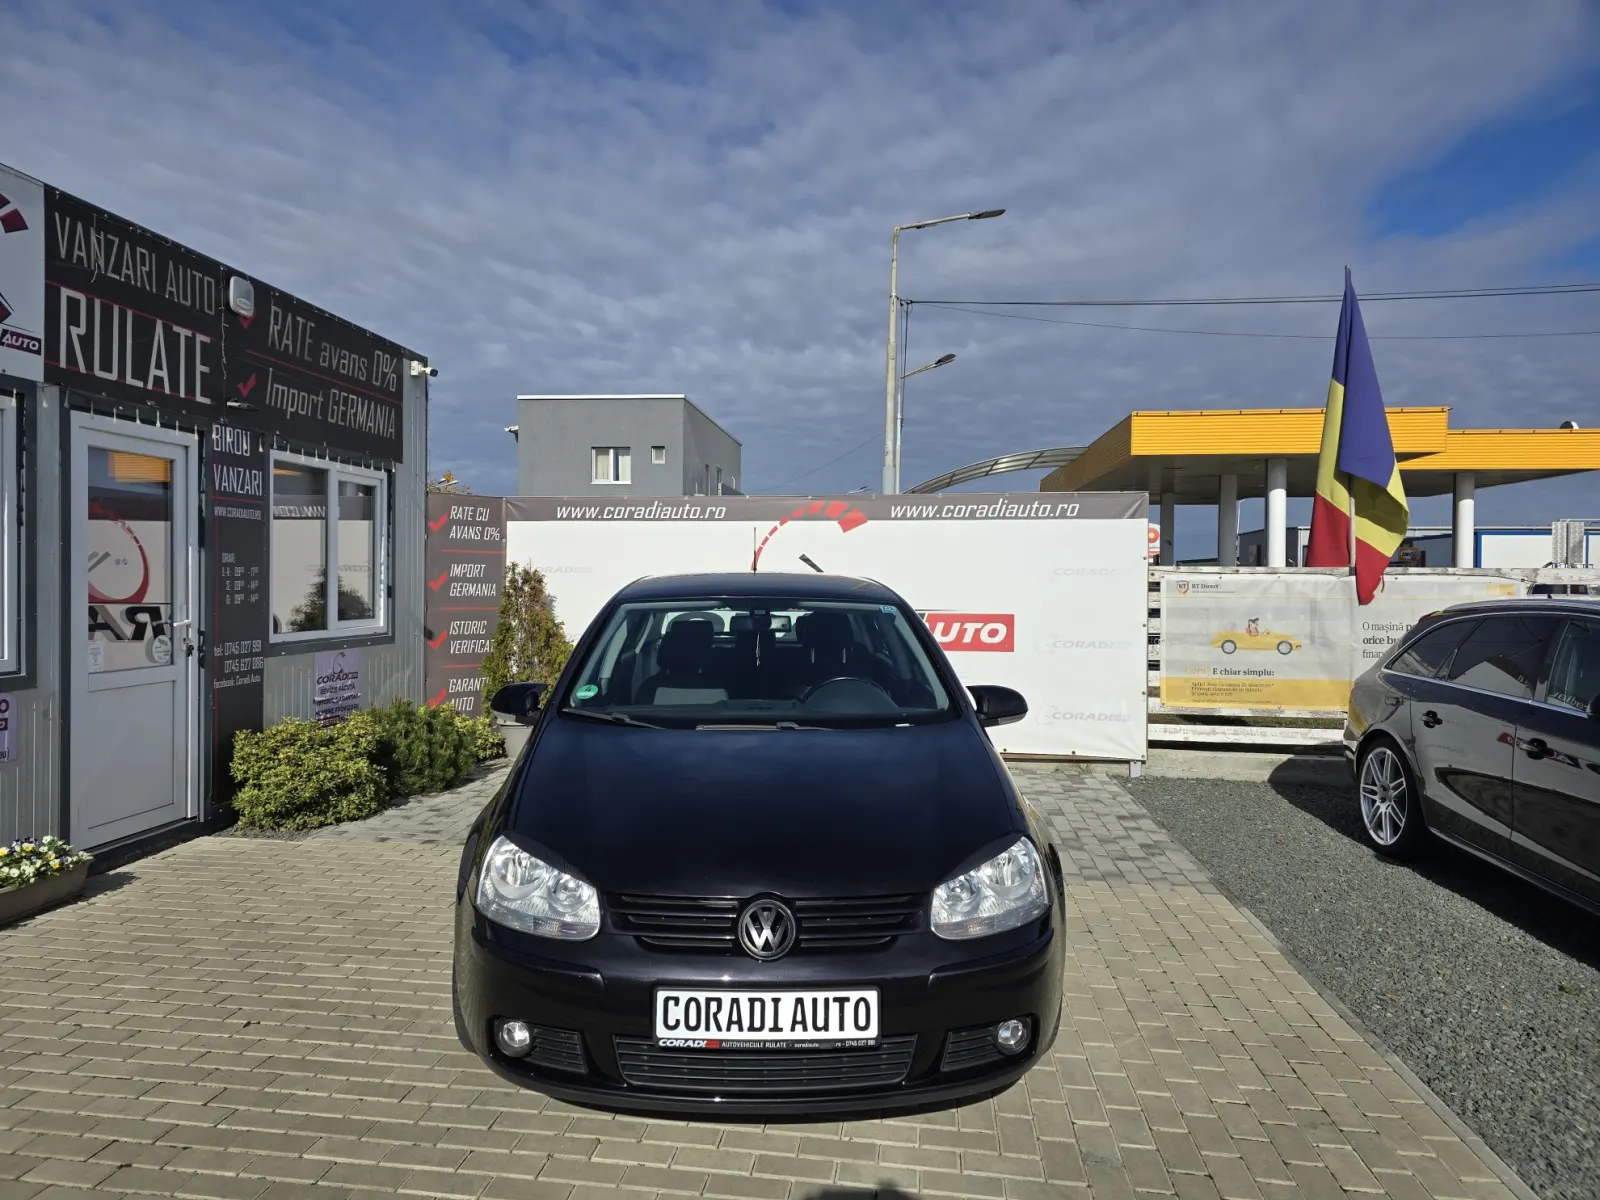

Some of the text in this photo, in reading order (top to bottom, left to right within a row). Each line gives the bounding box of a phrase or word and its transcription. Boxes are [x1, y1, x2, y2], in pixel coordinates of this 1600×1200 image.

[54, 211, 216, 316] VANZARI AUTO
[2, 333, 39, 350] AUTO
[59, 286, 212, 404] RULATE
[268, 305, 397, 392] RATE avans 0%
[266, 367, 396, 439] Import GERMANIA
[212, 424, 250, 457] BIROU
[213, 463, 263, 496] VANZARI
[450, 506, 490, 522] RATE CU
[556, 501, 727, 519] www.coradiauto.ro
[890, 498, 1080, 518] www.coradiauto.ro
[449, 525, 501, 541] AVANS 0%
[450, 564, 486, 578] IMPORT
[449, 582, 497, 597] GERMANIA
[449, 620, 487, 635] ISTORIC
[926, 622, 1008, 643] UTO
[1362, 621, 1370, 631] O
[1371, 621, 1404, 634] mașină
[225, 641, 240, 656] 0745
[240, 640, 252, 654] 027
[1362, 635, 1385, 645] orice
[225, 656, 264, 673] 0745 627 086
[1212, 667, 1218, 675] E
[1219, 667, 1241, 676] chiar
[1242, 667, 1275, 677] simplu:
[662, 995, 872, 1033] CORADI AUTO
[658, 1039, 707, 1048] CORADI
[721, 1041, 764, 1049] AUTOVEHICULE
[765, 1041, 787, 1049] RULATE
